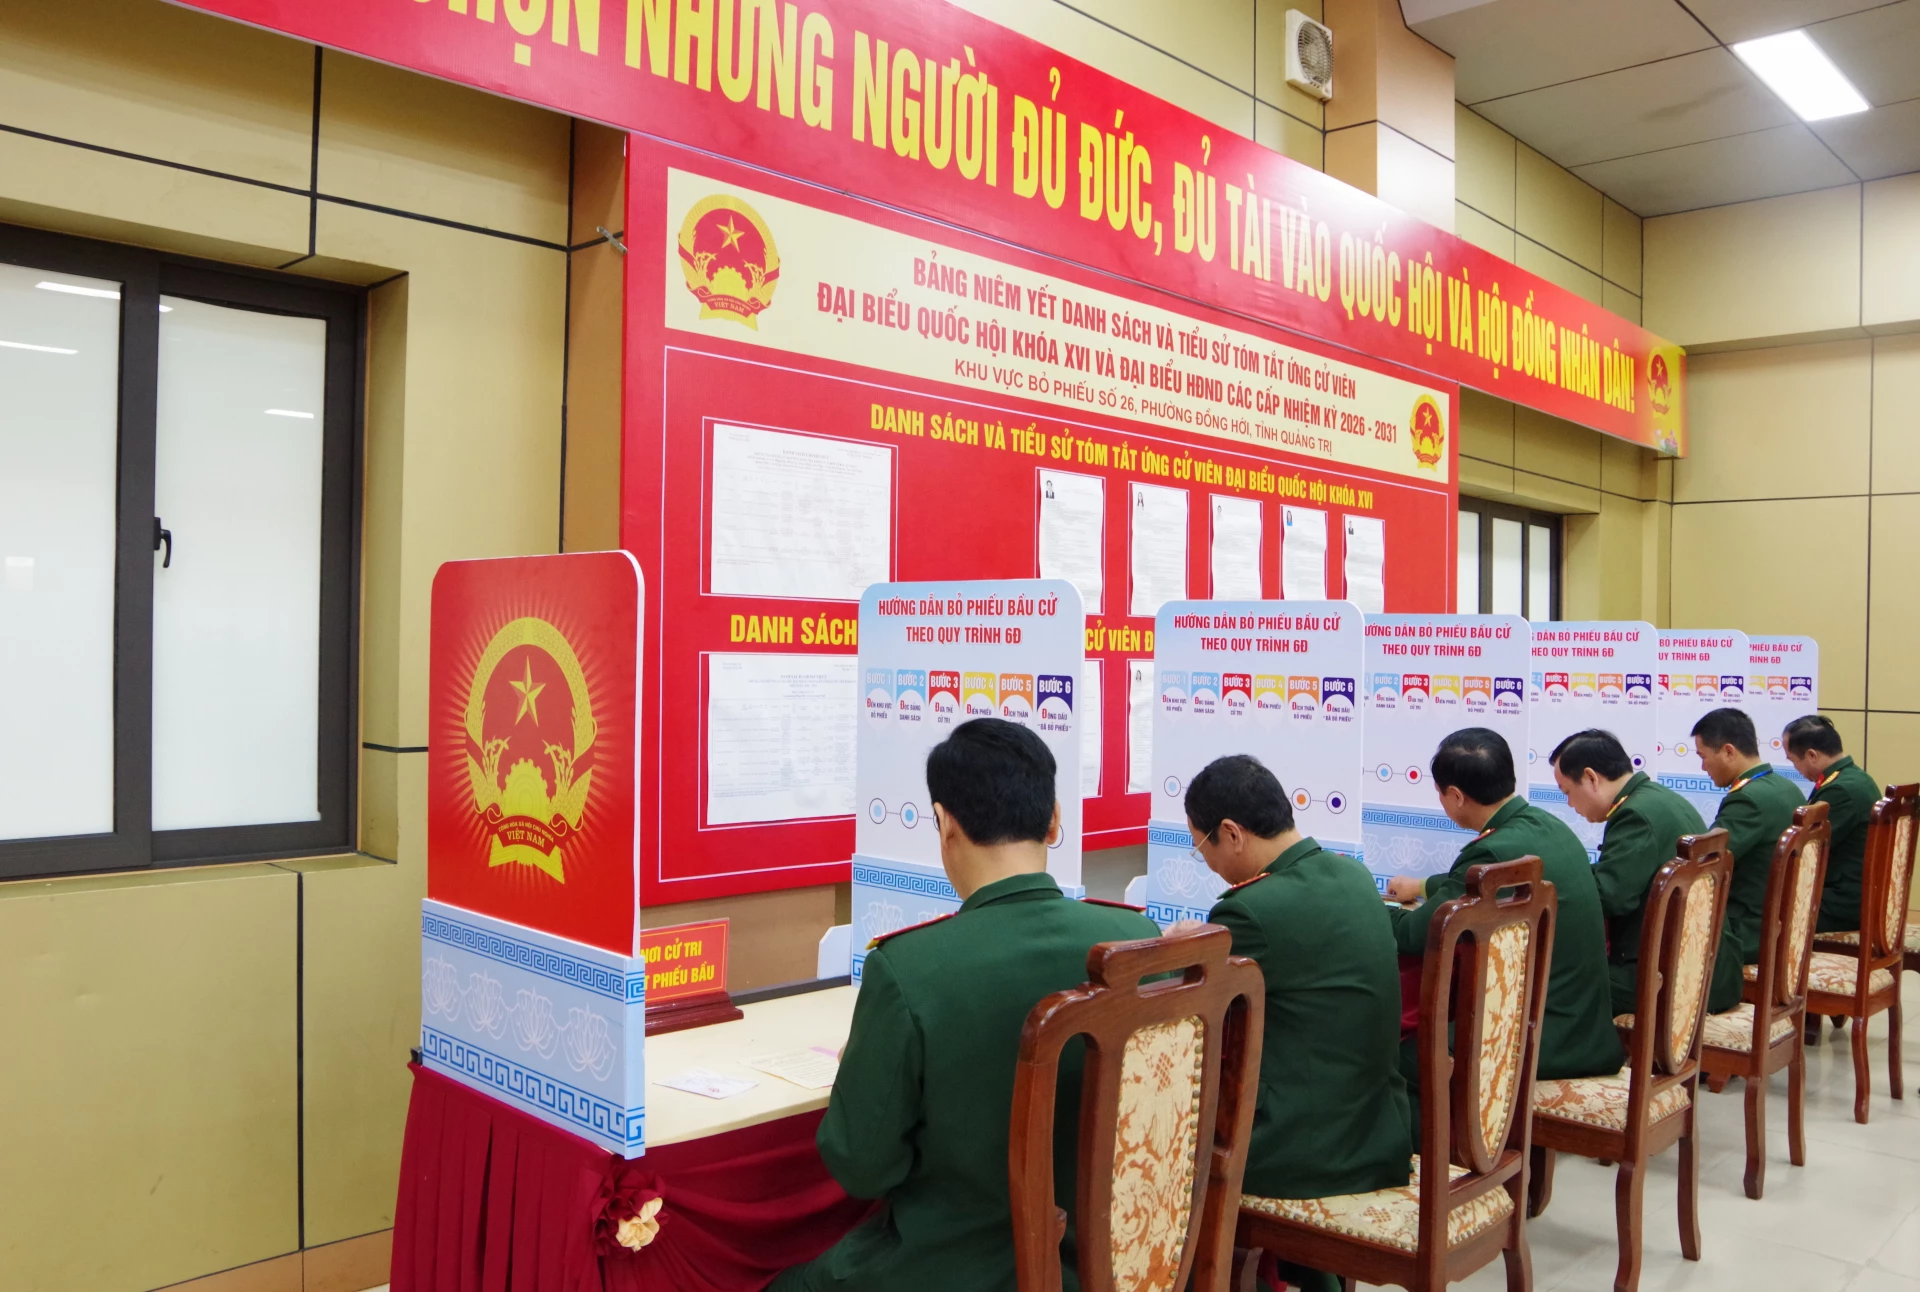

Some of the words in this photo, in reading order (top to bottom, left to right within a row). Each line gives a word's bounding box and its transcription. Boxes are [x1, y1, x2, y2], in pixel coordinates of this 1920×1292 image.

[852, 31, 998, 187] NGƯỜI
[1012, 67, 1066, 209] ĐỦ
[1079, 109, 1163, 256] ĐỨC,
[1173, 135, 1216, 262] ĐỦ
[1225, 173, 1271, 282] TÀI
[1279, 195, 1331, 302] VÀO
[1340, 221, 1402, 327] QUỐC
[1408, 251, 1442, 355] HỘI
[1448, 267, 1473, 353] VÀ
[1478, 282, 1507, 379] HỘI
[1512, 290, 1556, 385] ĐỒNG
[1560, 323, 1600, 401] NHÂN
[1603, 338, 1634, 413] DÂN!
[914, 250, 967, 298] BẢNG
[974, 274, 1021, 312] NIÊM
[1027, 286, 1057, 320] YẾT
[1062, 298, 1107, 334] DANH
[1111, 312, 1152, 346] SÁCH
[1156, 323, 1175, 352] VÀ
[1178, 325, 1208, 360] TIỂU
[1212, 335, 1230, 366] SỬ
[1233, 344, 1259, 374] TÓM
[1263, 350, 1285, 380] TẮT
[1287, 357, 1311, 388] ỨNG
[1314, 363, 1331, 393] CỬ
[1333, 373, 1356, 400] VIÊN
[816, 281, 855, 323] ĐẠI
[862, 288, 911, 331] BIỂU
[917, 307, 970, 344] QUỐC
[976, 319, 1007, 357] HỘI
[1012, 329, 1059, 366] KHÓA
[1063, 342, 1091, 373] XVI
[1095, 348, 1116, 378] VÀ
[1119, 356, 1145, 387] ĐẠI
[1149, 358, 1183, 394] BIỂU
[1185, 373, 1224, 403] HĐND
[1227, 382, 1253, 410] CÁC
[1255, 386, 1281, 416] CẤP
[1283, 397, 1321, 426] NHIỆM
[1323, 407, 1338, 430] KỲ
[1340, 411, 1366, 436] 2026
[1374, 420, 1397, 443] 2031
[955, 359, 988, 381] KHU
[993, 367, 1024, 390] VỰC
[1028, 372, 1049, 393] BỎ
[1053, 380, 1094, 404] PHIẾU
[1099, 387, 1117, 407] SỐ
[1120, 396, 1138, 415] 26,
[1141, 399, 1193, 424] PHƯỜNG
[1195, 408, 1228, 431] ĐỒNG
[1231, 417, 1252, 438] HỚI,
[1255, 421, 1278, 442] TỈNH
[1280, 429, 1315, 450] QUẢNG
[1317, 438, 1332, 456] TRỊ
[871, 404, 924, 436] DANH
[930, 412, 978, 445] SÁCH
[984, 421, 1006, 450] VÀ
[1011, 423, 1045, 456] TIỂU
[1051, 428, 1074, 460] SỬ
[1076, 438, 1108, 466] TÓM
[1112, 442, 1137, 470] TẮT
[1141, 446, 1169, 476] ỨNG
[1173, 452, 1192, 480] CỬ
[1194, 459, 1222, 485] VIÊN
[1226, 467, 1245, 492] ĐẠI
[1249, 468, 1275, 493] BIỂU
[1278, 474, 1306, 498] QUỐC
[1310, 480, 1326, 504] HỘI
[1329, 484, 1355, 506] KHÓA
[1358, 490, 1373, 509] XVI
[878, 594, 916, 616] HƯỚNG
[919, 594, 944, 616] DẪN
[946, 593, 963, 616] BỎ
[966, 594, 1004, 616] PHIẾU
[1007, 594, 1035, 616] BẦU
[1037, 592, 1058, 616] CỬ
[731, 615, 793, 643] DANH
[801, 613, 857, 645] SÁCH
[1174, 612, 1211, 629] HƯỚNG
[1213, 612, 1237, 630] DẪN
[1239, 612, 1255, 630] BỎ
[1257, 612, 1293, 631] PHIẾU
[1294, 612, 1320, 631] BẦU
[1322, 612, 1341, 631] CỬ
[1365, 623, 1391, 637] ƯỚNG
[906, 626, 935, 643] THEO
[937, 626, 961, 644] QUY
[964, 624, 1002, 644] TRÌNH
[1004, 627, 1022, 644] 6Đ
[1085, 620, 1107, 651] CỬ
[1108, 626, 1141, 652] VIÊN
[1200, 637, 1228, 651] THEO
[1230, 638, 1253, 652] QUY
[1255, 637, 1291, 653] TRÌNH
[1292, 639, 1309, 653] 6Đ
[1383, 643, 1407, 655] THEO
[1410, 644, 1430, 656] QUY
[1434, 642, 1465, 657] TRÌNH
[1468, 646, 1482, 657] 6Đ
[1531, 647, 1548, 656] HEO
[1658, 652, 1669, 661] UY
[930, 672, 951, 688] BƯỚC
[953, 676, 958, 688] 3
[1001, 676, 1023, 691] BƯỚC
[1026, 680, 1031, 691] 5
[1039, 677, 1062, 693] BƯỚC
[1065, 682, 1071, 693] 6
[507, 828, 525, 842] VIỆT
[526, 831, 545, 848] NAM
[664, 937, 683, 961] CỬ
[684, 940, 702, 957] TRI
[652, 965, 688, 989] PHIẾU
[691, 961, 714, 983] BẦU
